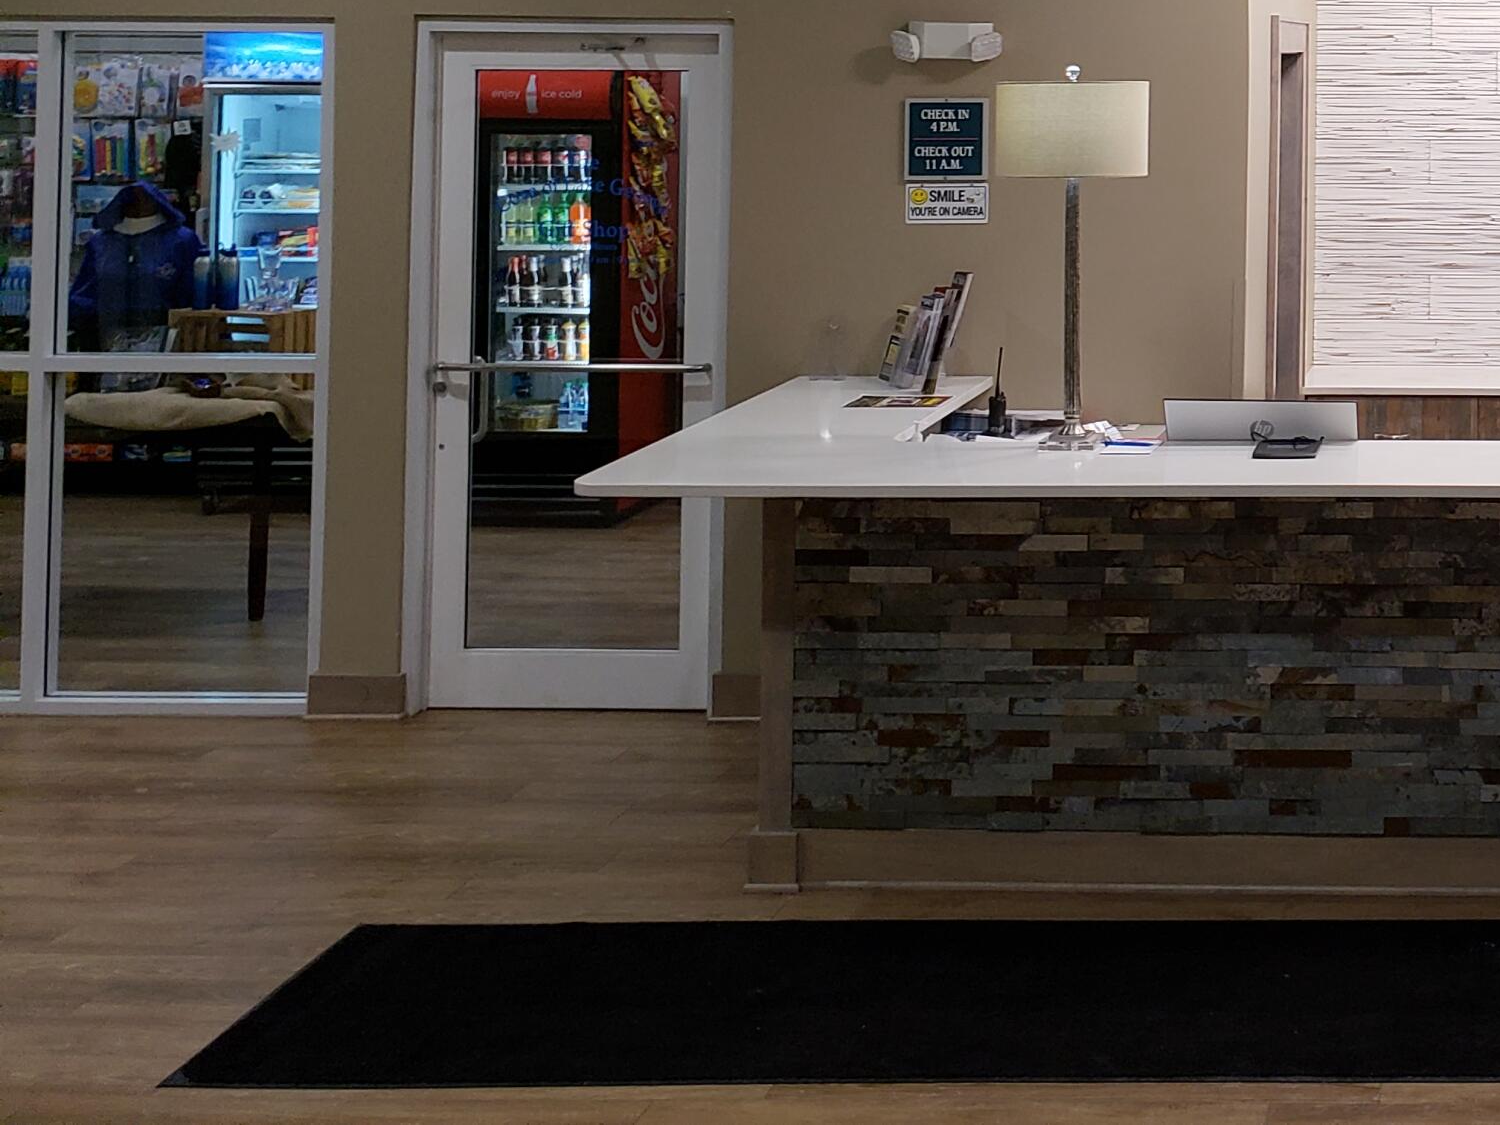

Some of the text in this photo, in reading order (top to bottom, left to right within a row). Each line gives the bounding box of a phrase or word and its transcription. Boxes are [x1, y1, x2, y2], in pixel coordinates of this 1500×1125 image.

[490, 88, 583, 100] enjoy ice cold
[920, 108, 970, 120] CHECK IN
[930, 121, 938, 132] 4
[914, 146, 974, 158] CHECK OUT
[925, 159, 937, 170] 11
[929, 190, 965, 203] SMILE
[910, 206, 984, 217] YOU'RE ON CAMERA
